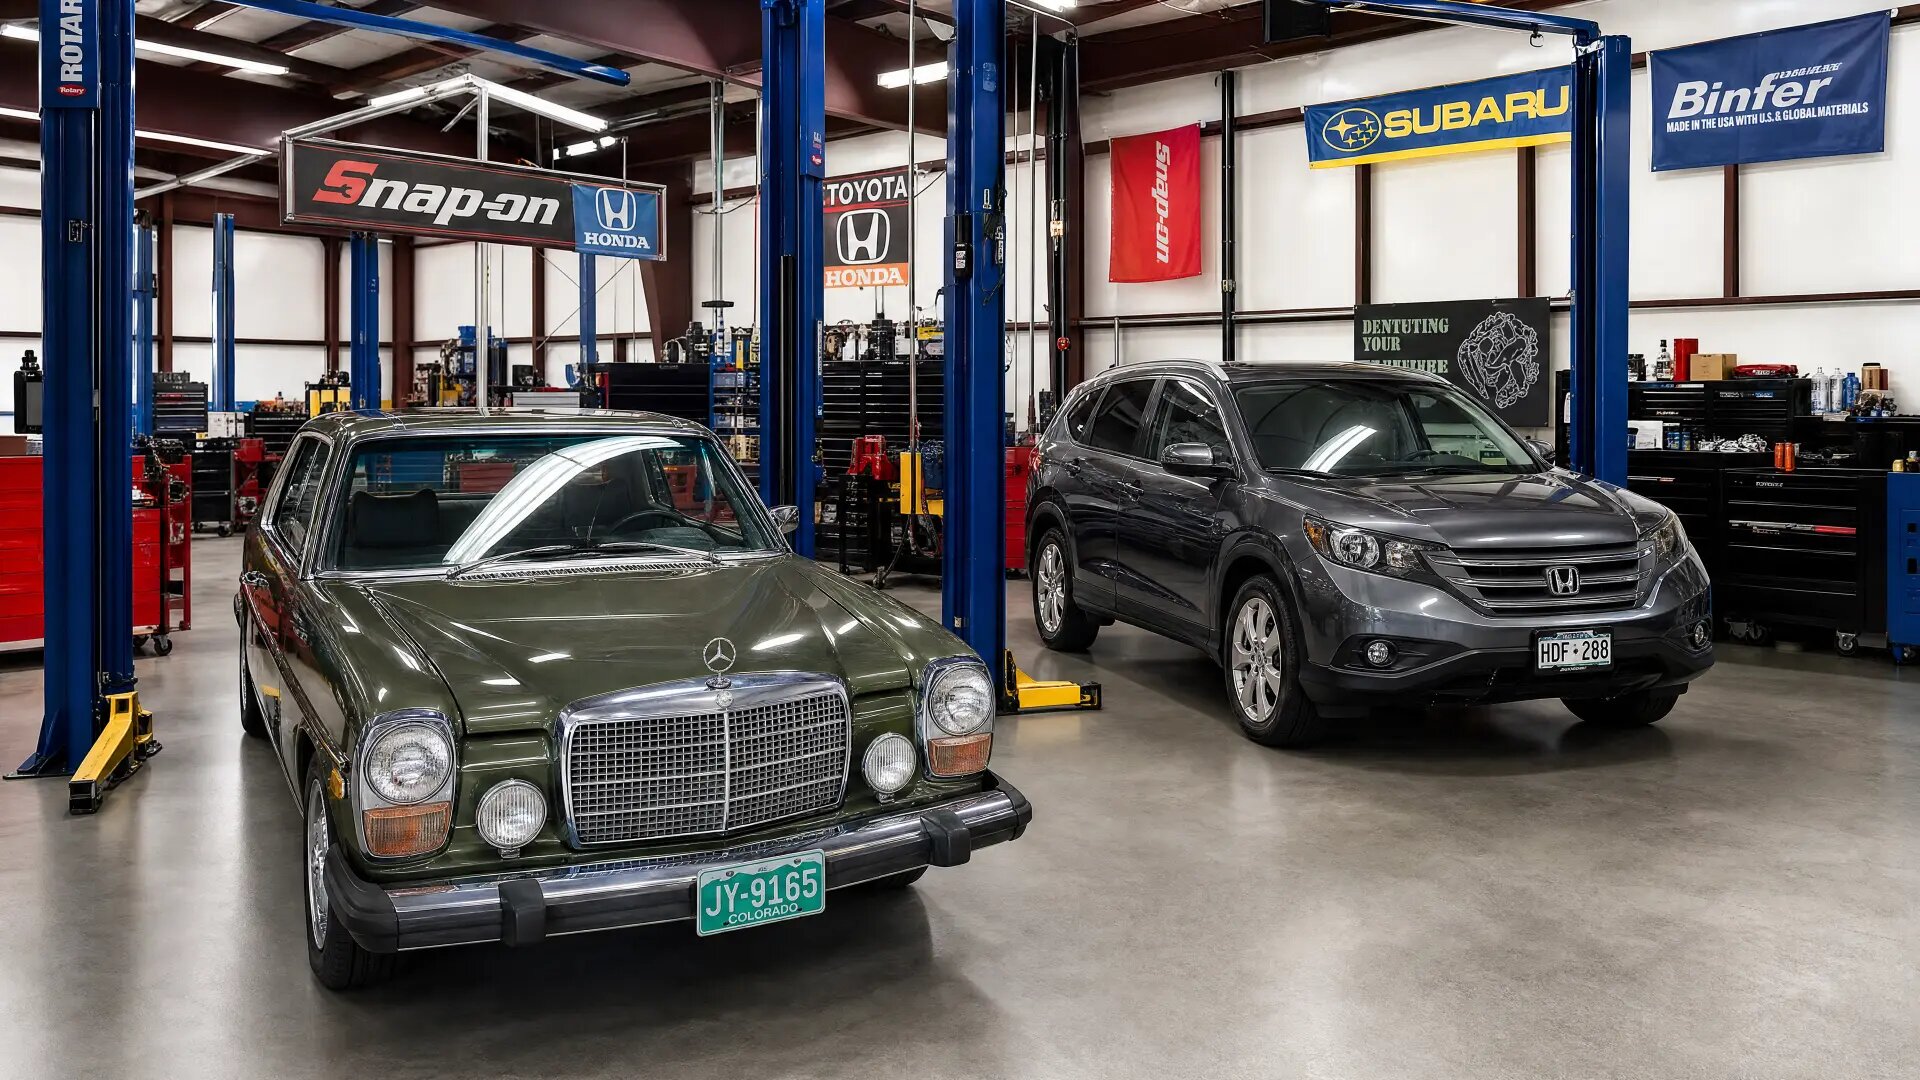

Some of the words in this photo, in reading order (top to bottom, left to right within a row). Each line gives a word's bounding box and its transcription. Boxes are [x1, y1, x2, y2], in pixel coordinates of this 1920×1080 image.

[60, 0, 83, 82] ROTAR
[59, 86, 85, 95] Rotary
[1667, 72, 1833, 119] Binfer
[1384, 85, 1570, 139] SUBARU
[1666, 120, 1690, 133] MADE
[1691, 119, 1700, 131] IN
[1701, 118, 1717, 130] THE
[1717, 116, 1735, 128] USA
[1735, 113, 1758, 126] WITH
[1759, 111, 1775, 124] U.S.
[1775, 110, 1782, 122] &
[1782, 107, 1817, 121] GLOBAL
[1817, 101, 1869, 118] MATERIALS
[312, 159, 560, 226] Snap-on
[823, 175, 908, 206] TOYOTA
[1151, 140, 1171, 264] Snap-on
[583, 231, 651, 250] HONDA
[825, 267, 904, 287] HONDA
[1362, 336, 1401, 352] YOUR
[1541, 641, 1570, 663] HDF
[1582, 639, 1609, 661] 288
[705, 868, 818, 917] JY-9165
[728, 902, 799, 924] COLORADO
